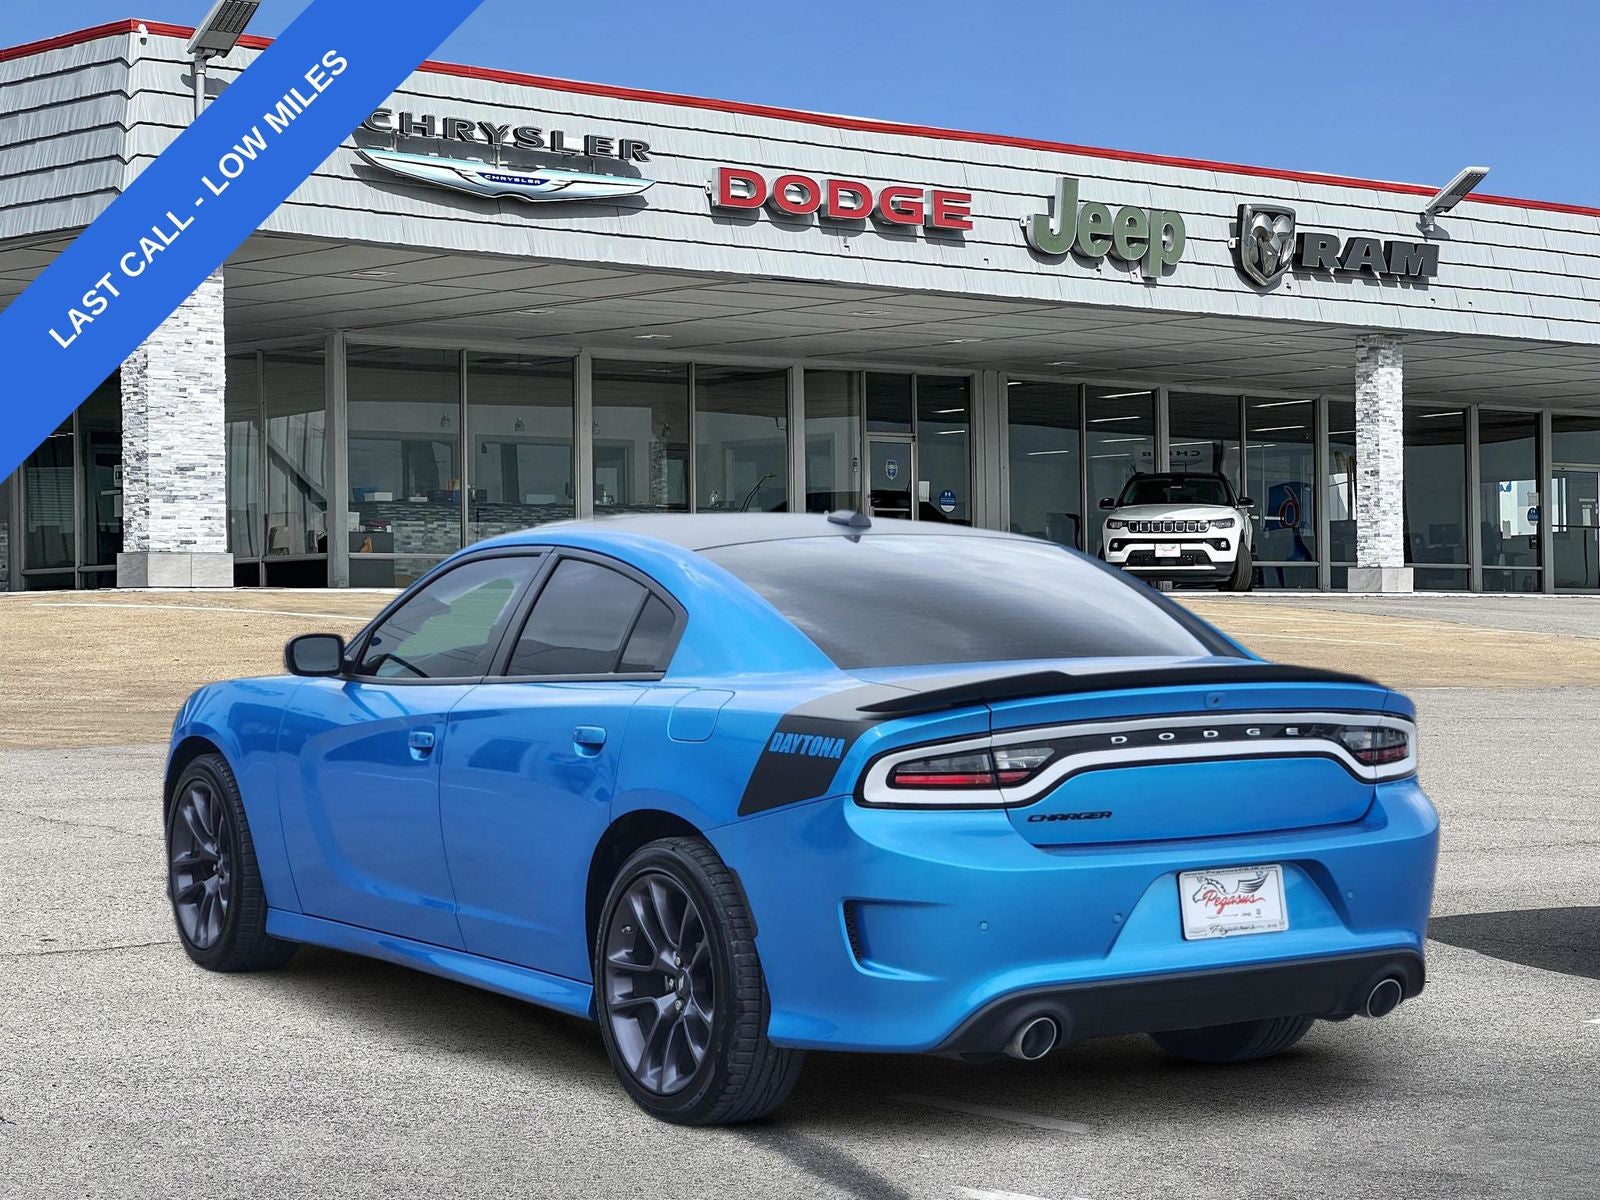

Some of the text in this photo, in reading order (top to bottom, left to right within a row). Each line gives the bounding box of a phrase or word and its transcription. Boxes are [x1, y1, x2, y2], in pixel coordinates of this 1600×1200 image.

[362, 107, 651, 162] CHRYSLER
[484, 174, 541, 185] CHRYSLER
[713, 167, 974, 231] DODGE
[1027, 177, 1187, 277] Jeep
[1298, 232, 1440, 277] RAM
[768, 731, 846, 760] DAYTONA
[1110, 726, 1300, 745] DODGE
[1026, 810, 1113, 824] CHARGER
[1202, 888, 1266, 915] Pegasus
